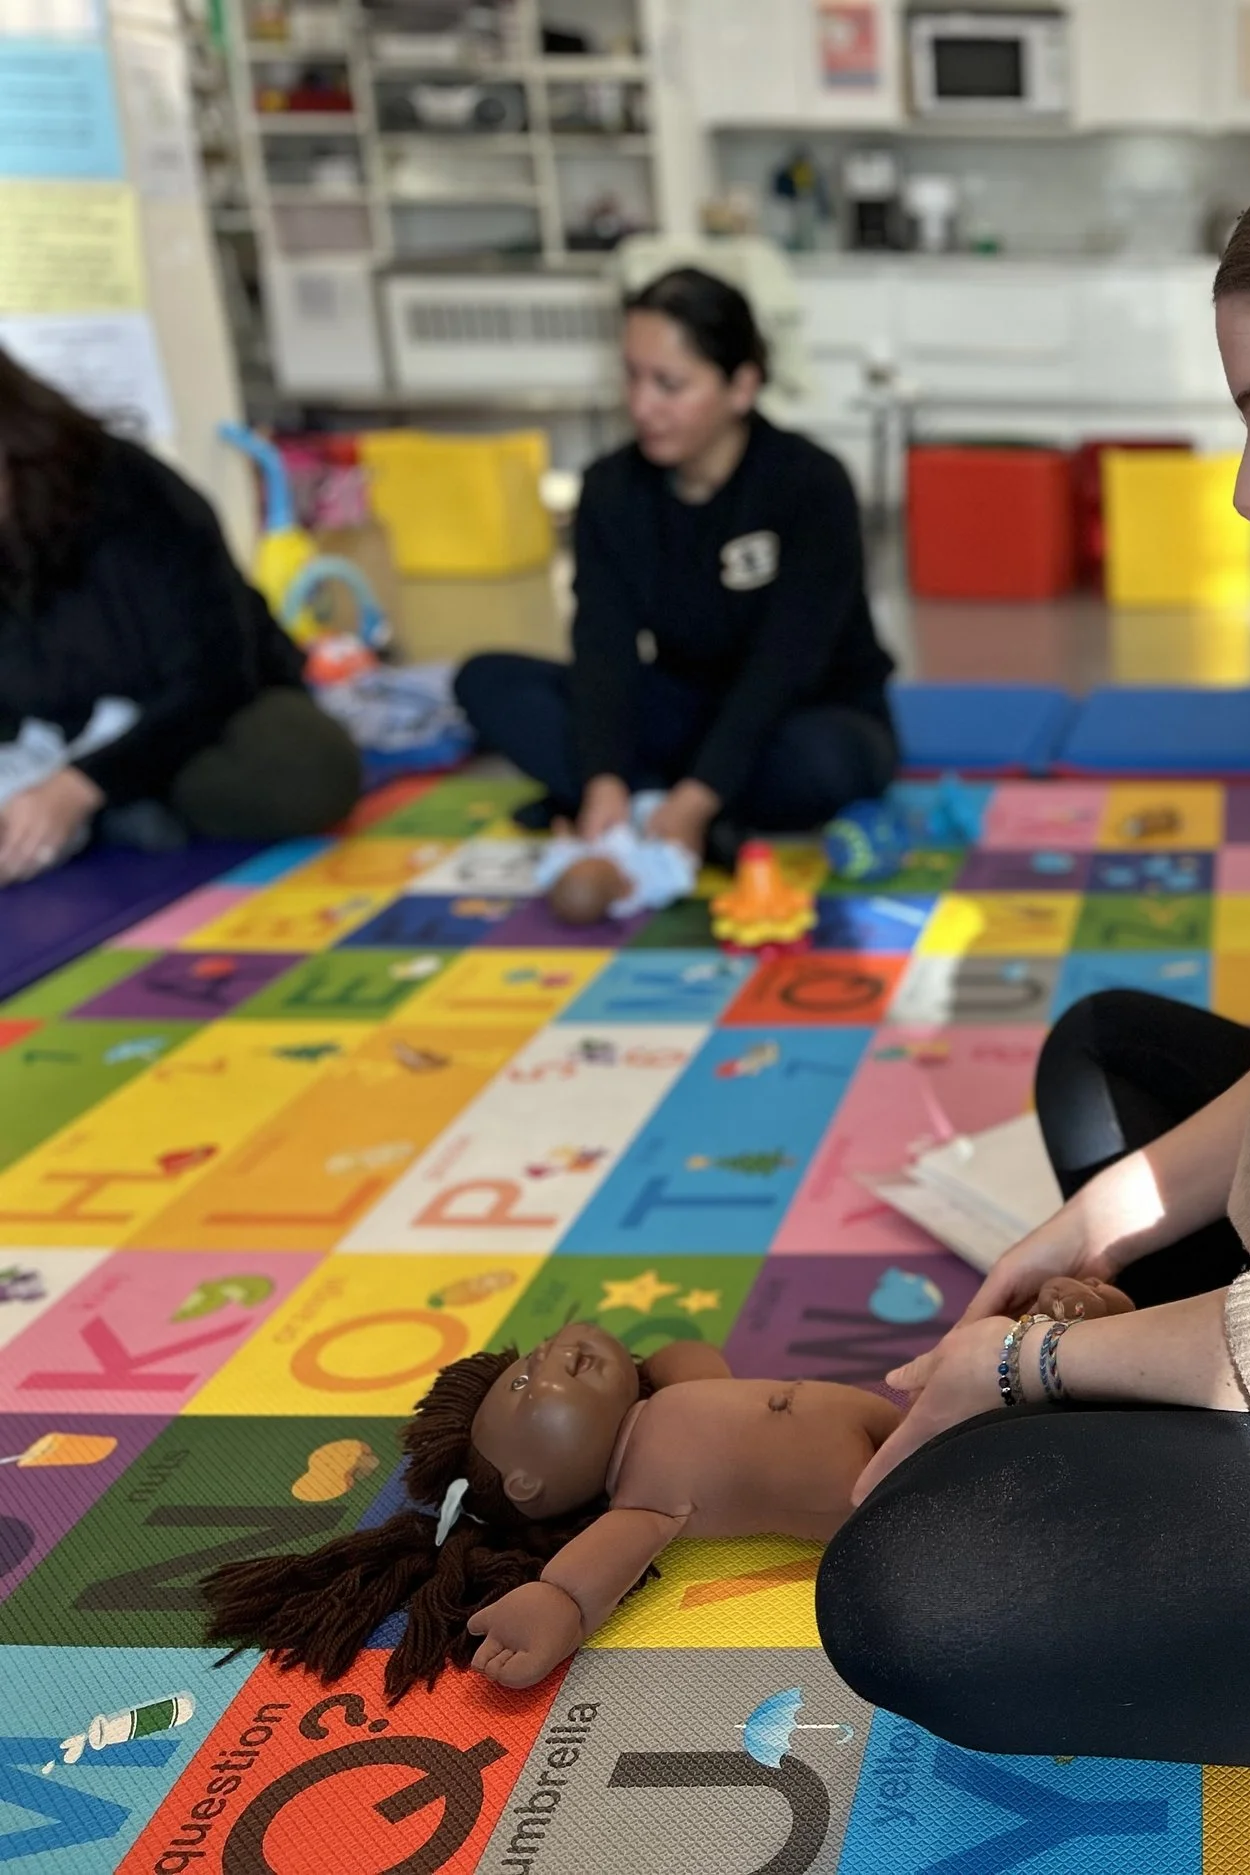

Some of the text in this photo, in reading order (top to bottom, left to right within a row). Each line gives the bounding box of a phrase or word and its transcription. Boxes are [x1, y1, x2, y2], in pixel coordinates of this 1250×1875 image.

[409, 1178, 560, 1230] P
[617, 1175, 779, 1230] T
[14, 1315, 256, 1393] K
[289, 1308, 471, 1393] O
[127, 1448, 192, 1503] nuts
[69, 1504, 350, 1612] N
[153, 1702, 292, 1875] question
[221, 1735, 510, 1875] Q
[500, 1702, 603, 1875] umbrella
[606, 1751, 832, 1875] U
[873, 1718, 924, 1826] yello
[910, 1744, 1168, 1875] Y
